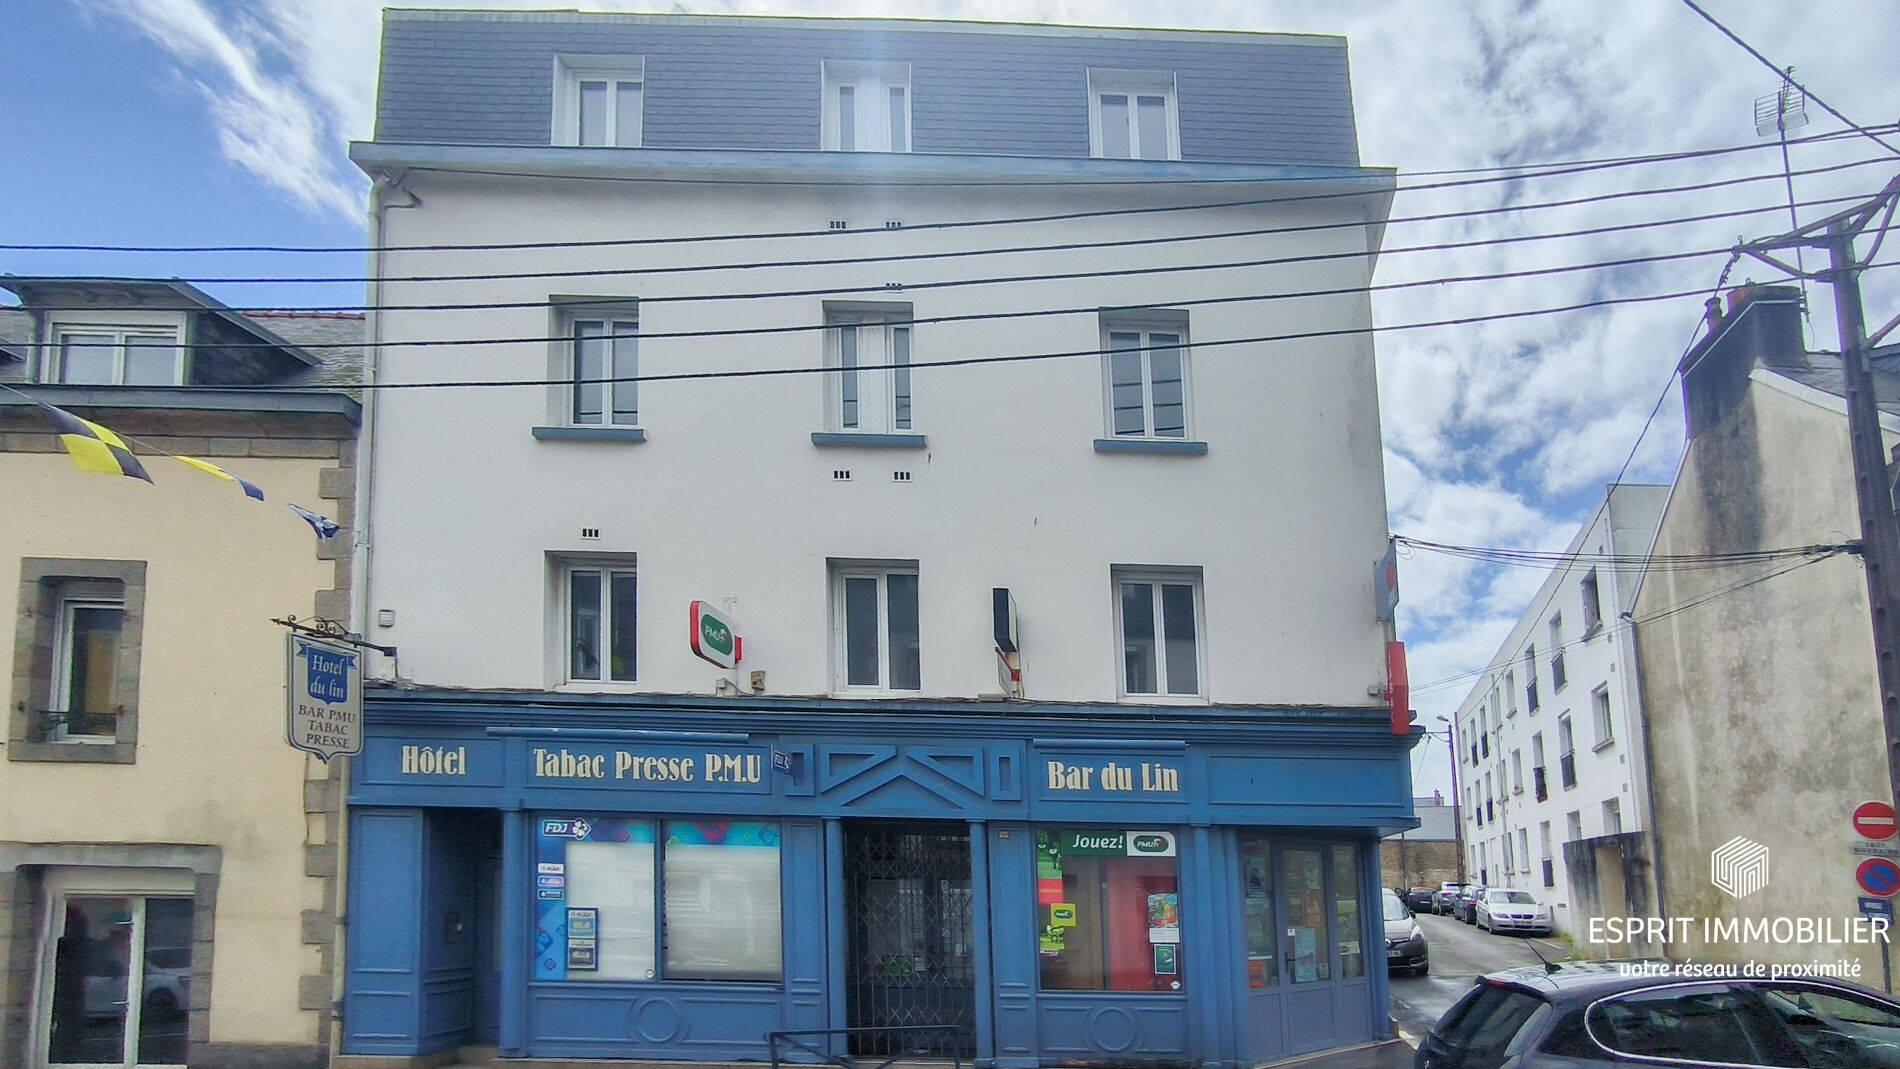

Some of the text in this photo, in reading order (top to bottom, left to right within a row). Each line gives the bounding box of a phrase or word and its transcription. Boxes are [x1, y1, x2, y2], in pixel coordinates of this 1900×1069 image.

[704, 624, 720, 642] PMU
[310, 675, 325, 695] du
[298, 704, 356, 723] BAR PMU
[307, 719, 349, 735] TABAC
[305, 733, 350, 749] PRESSE
[401, 745, 467, 775] Hôtel
[533, 748, 762, 784] Tabac Presse P.M.U
[1047, 761, 1178, 792] Bar du Lin
[545, 822, 568, 834] FDJ
[1072, 834, 1124, 849] Jouez!
[1137, 840, 1154, 848] PMU
